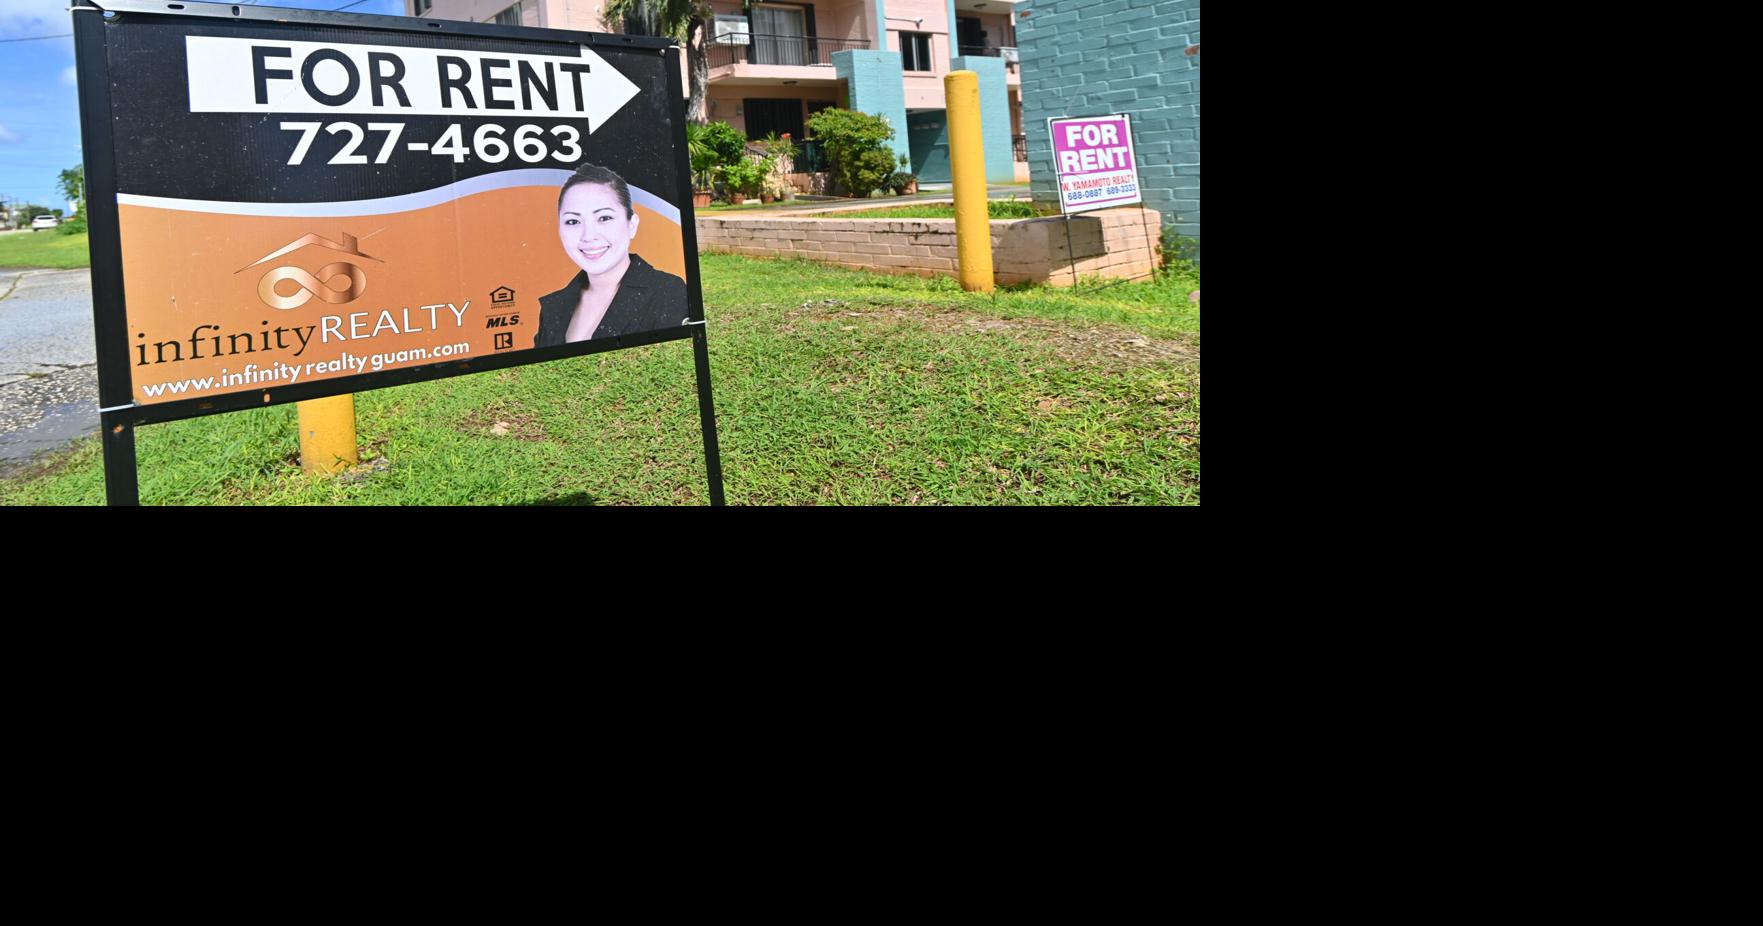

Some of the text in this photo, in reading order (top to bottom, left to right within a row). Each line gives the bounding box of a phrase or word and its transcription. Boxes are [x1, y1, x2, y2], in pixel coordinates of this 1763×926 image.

[251, 45, 591, 112] FOR RENT
[279, 121, 583, 166] 727-4663
[1065, 123, 1119, 148] FOR
[1060, 146, 1128, 173] RENT
[1072, 177, 1111, 191] YAMAMOTO
[1112, 175, 1135, 186] REALTY
[486, 314, 520, 329] MLS
